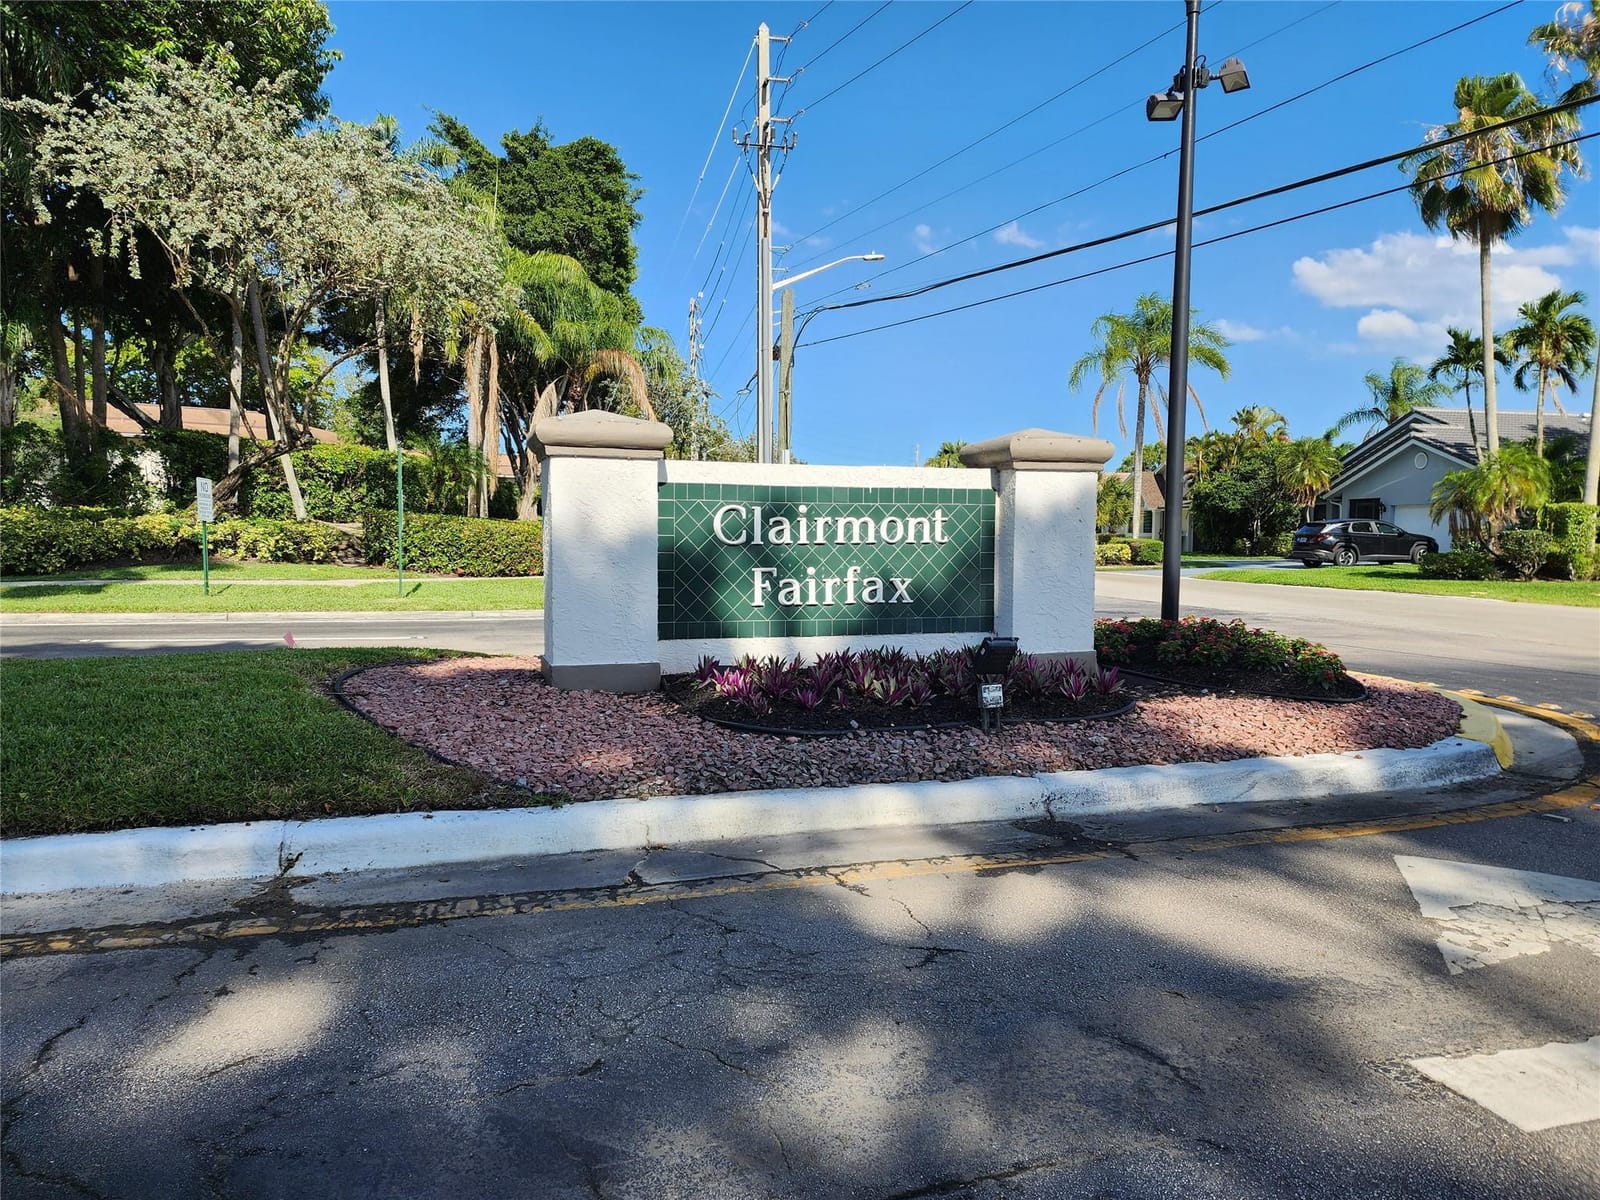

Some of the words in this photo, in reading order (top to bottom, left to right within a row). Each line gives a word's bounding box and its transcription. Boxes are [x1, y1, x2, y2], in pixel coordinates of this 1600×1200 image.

[200, 481, 209, 493] NO
[712, 504, 949, 545] Clairmont
[751, 566, 914, 607] Fairfax
